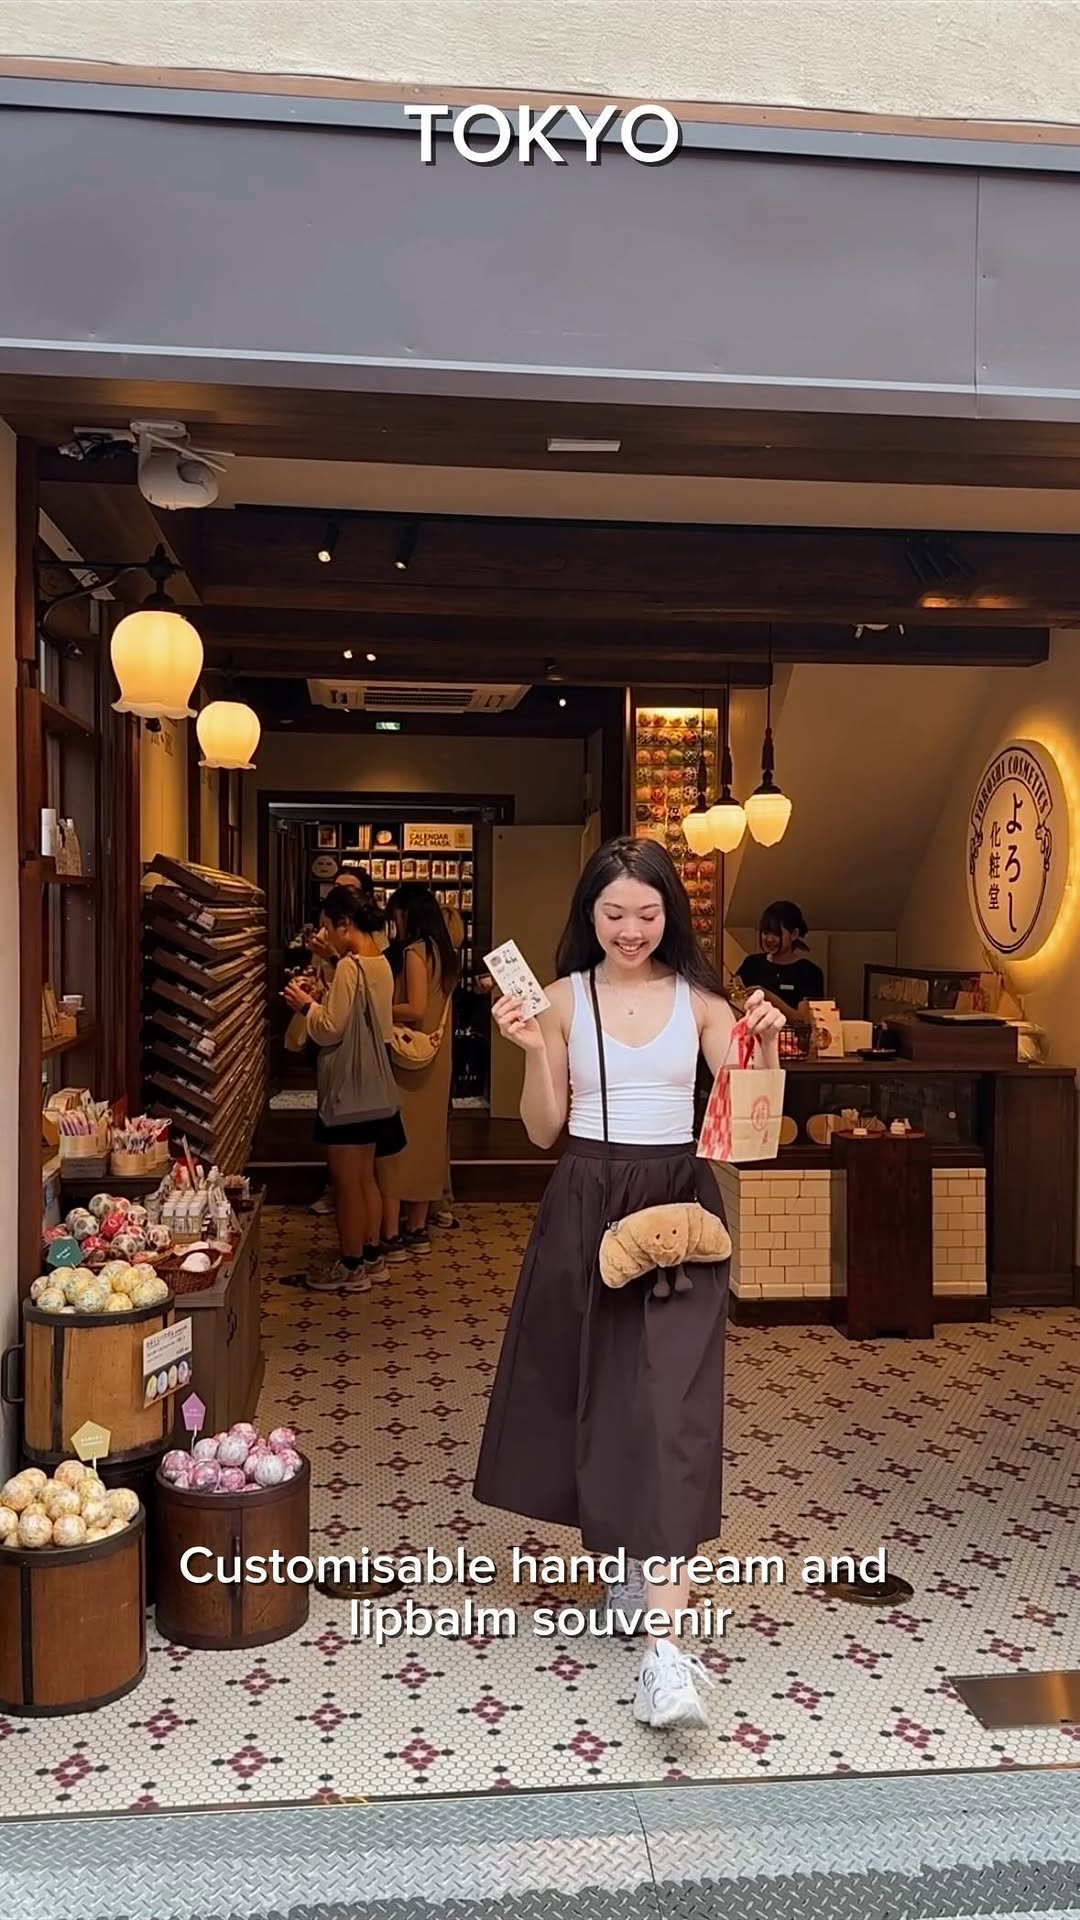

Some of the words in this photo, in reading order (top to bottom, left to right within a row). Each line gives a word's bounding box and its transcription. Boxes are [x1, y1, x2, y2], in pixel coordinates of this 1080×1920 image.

[975, 764, 1006, 822] YOROSHI
[1008, 756, 1050, 815] COSMETICS
[430, 839, 452, 847] MASK
[988, 821, 1001, 910] 化粧堂
[1004, 792, 1023, 933] よろし
